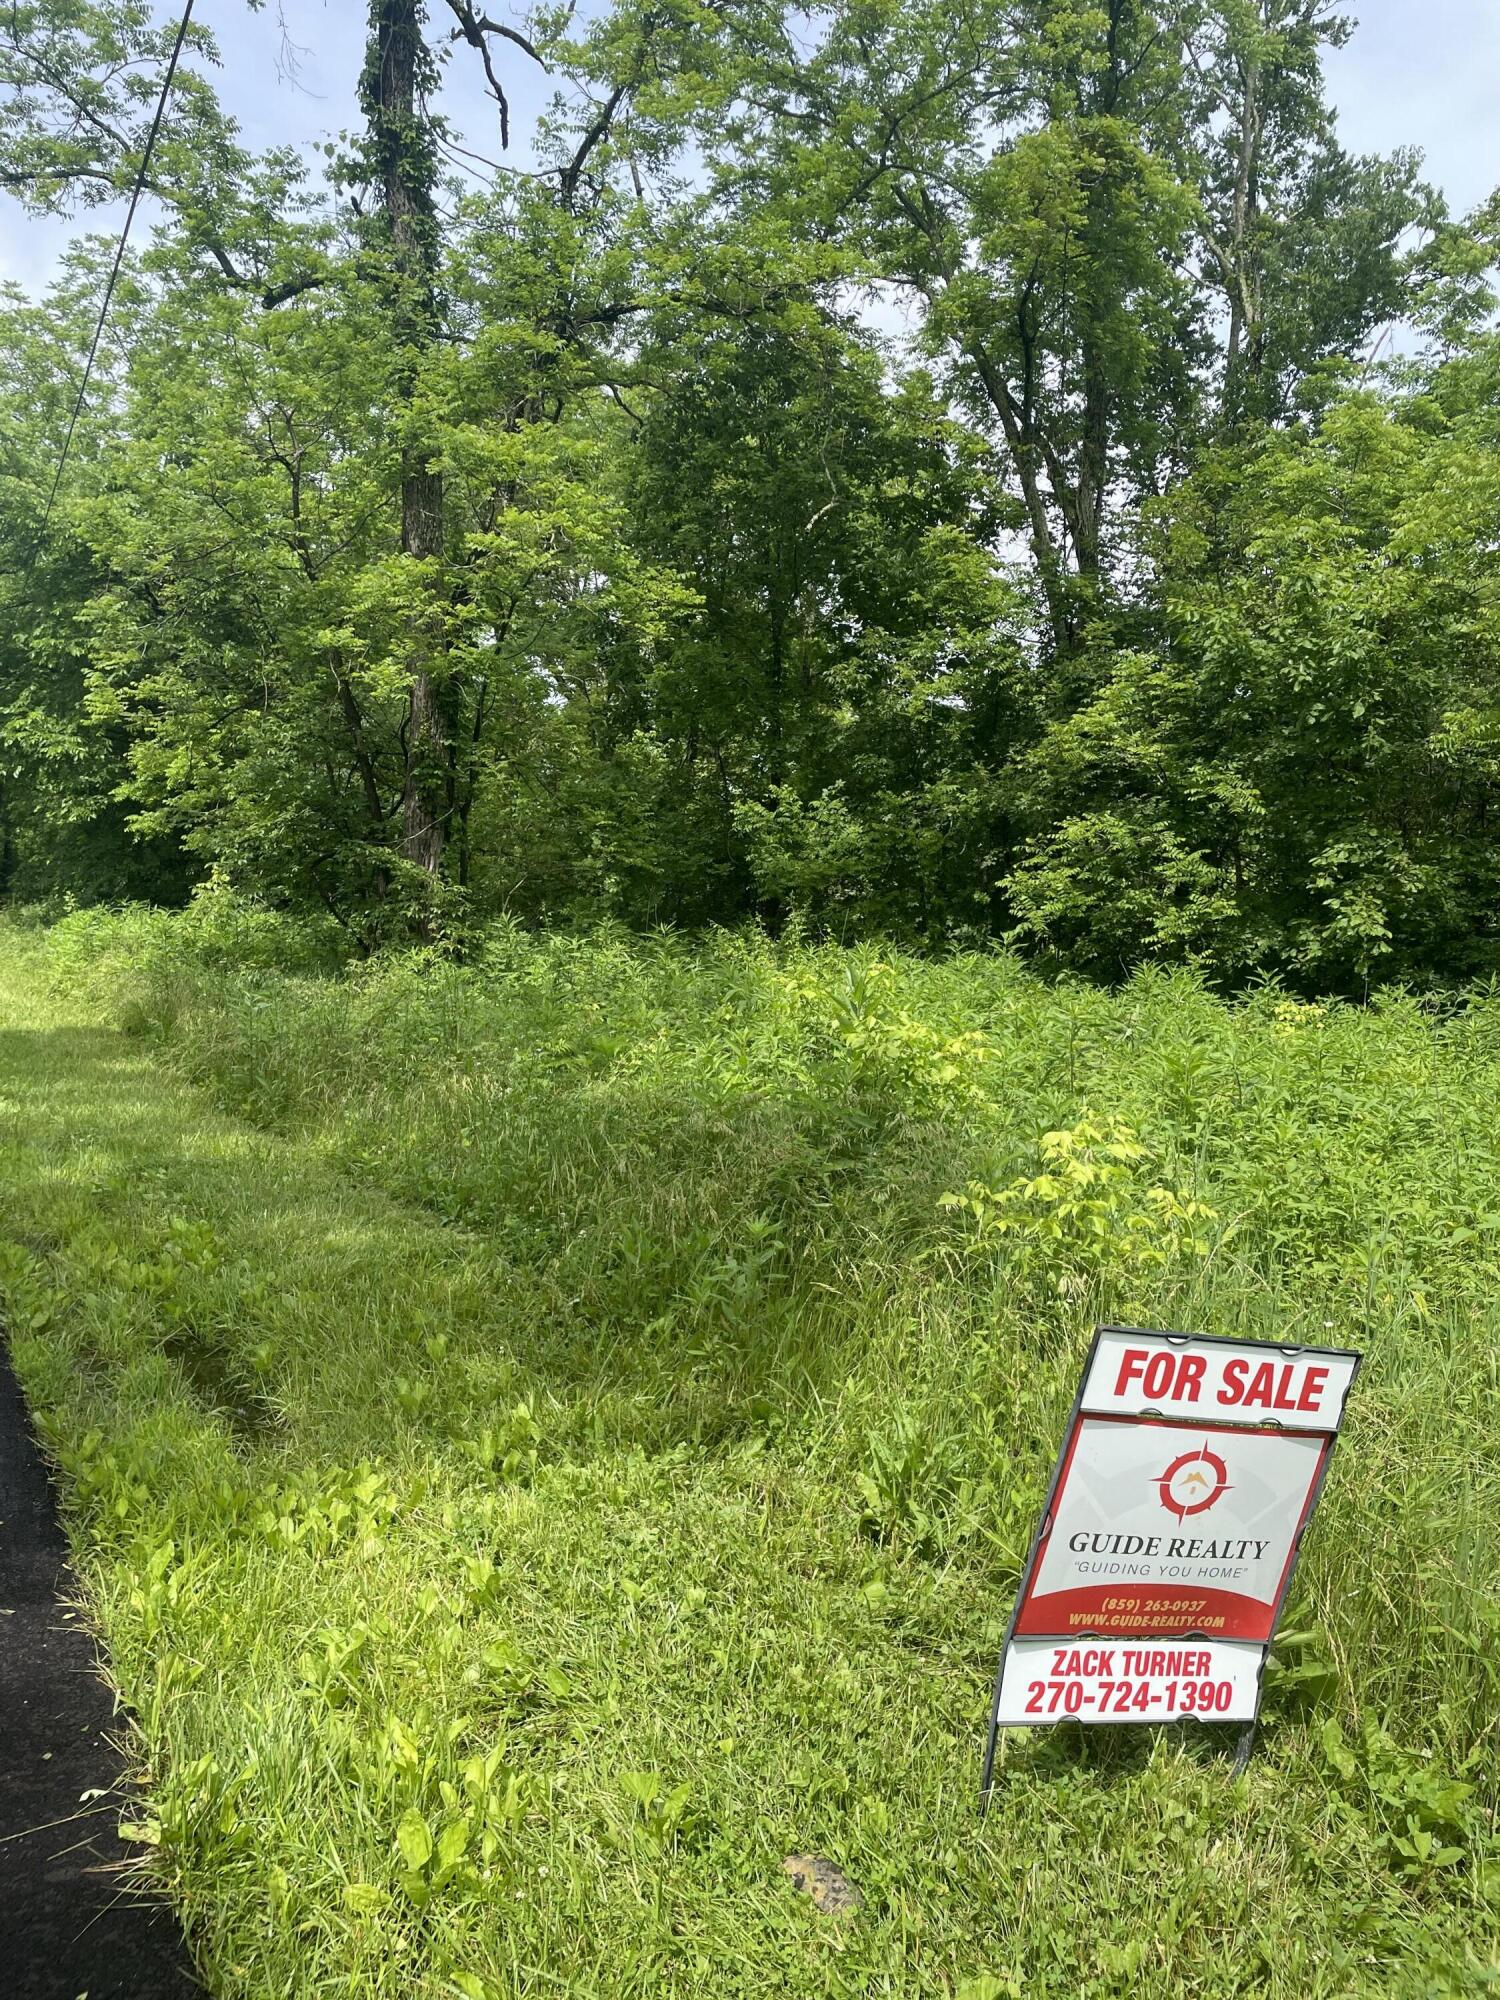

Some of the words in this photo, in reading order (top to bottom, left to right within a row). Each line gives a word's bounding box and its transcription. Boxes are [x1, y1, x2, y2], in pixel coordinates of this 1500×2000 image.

[1113, 1349, 1208, 1402] FOR
[1216, 1359, 1330, 1412] SALE
[1068, 1532, 1162, 1557] GUIDE
[1166, 1537, 1271, 1560] REALTY
[1159, 1566, 1192, 1577] YOU
[1101, 1597, 1140, 1613] (859)
[1143, 1600, 1208, 1612] 263-0937
[1068, 1613, 1226, 1628] WWW.GUIDE-REALTY.COM
[1050, 1650, 1116, 1677] ZACK
[1122, 1651, 1213, 1677] TURNER
[1025, 1681, 1234, 1713] 270-724-1390
